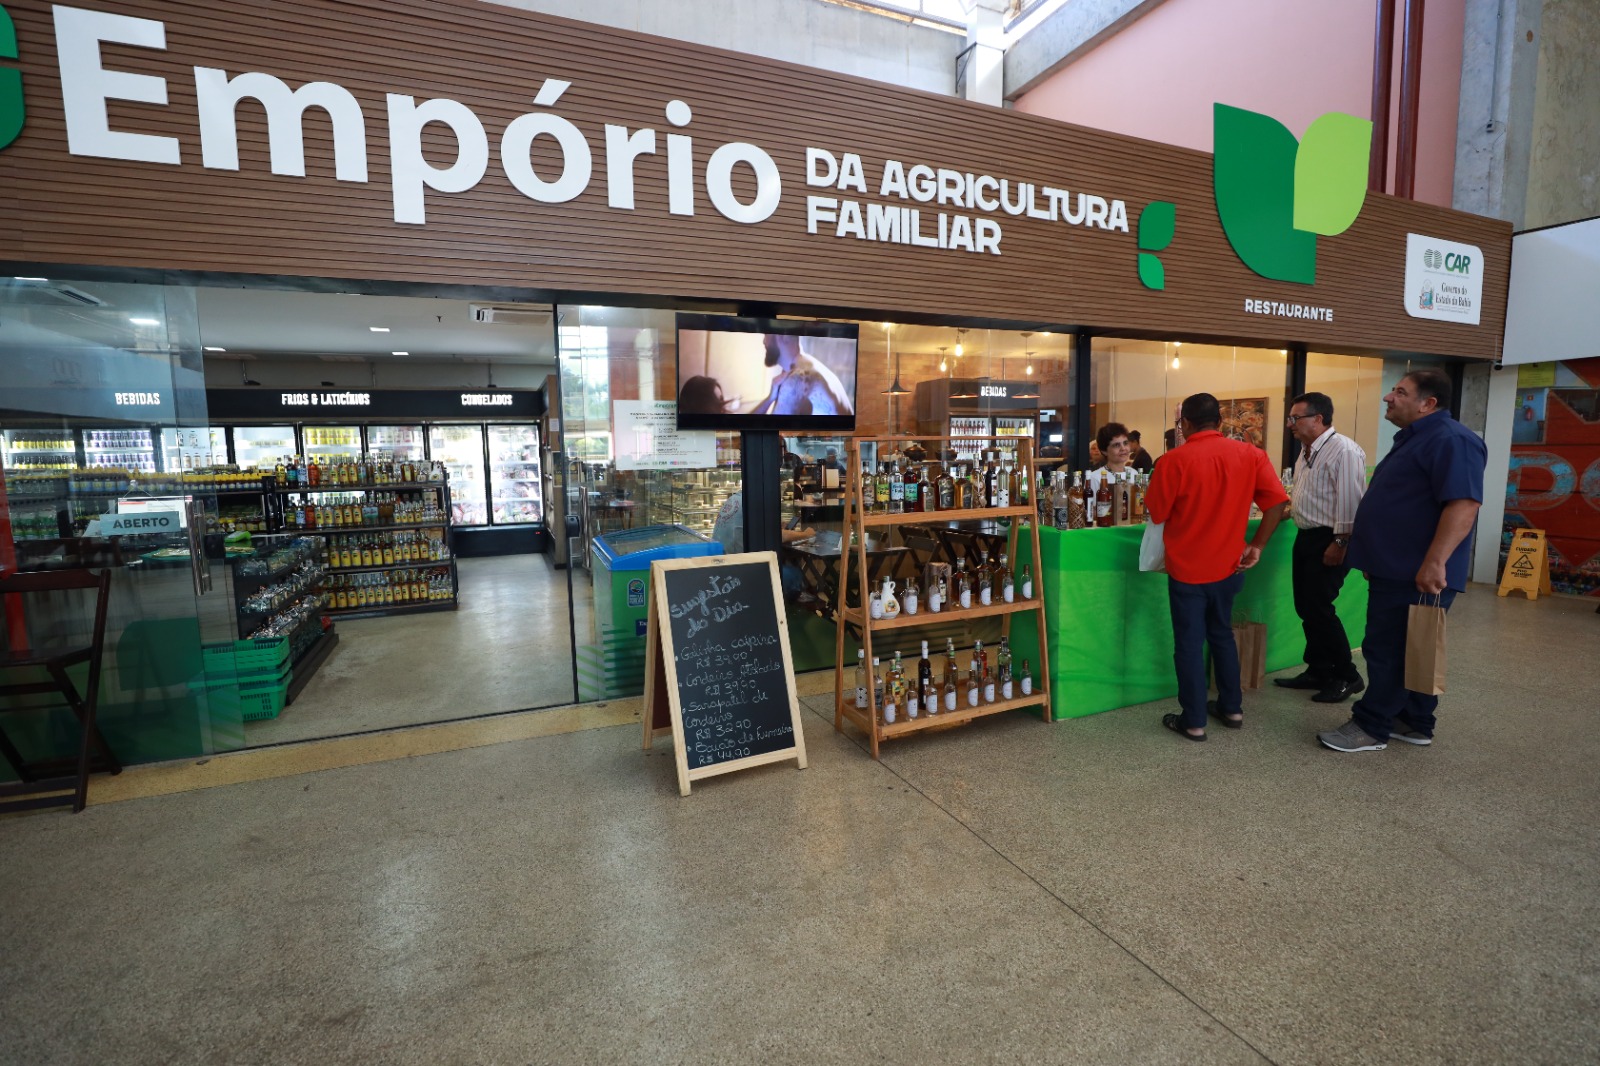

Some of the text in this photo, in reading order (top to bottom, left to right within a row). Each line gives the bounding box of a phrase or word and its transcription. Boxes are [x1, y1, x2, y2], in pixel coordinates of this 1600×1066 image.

[52, 4, 782, 225] Empório
[805, 147, 1130, 233] DA AGRICULTURA
[806, 195, 1002, 255] FAMILIAR
[1445, 252, 1471, 274] CAR
[1245, 299, 1333, 322] RESTAURANTE
[115, 392, 160, 405] BEBIDAS
[281, 393, 309, 405] FRIOS
[320, 391, 370, 405] LATICÍNIOS
[981, 386, 1007, 397] BEBIDAS
[461, 393, 513, 405] CONGELADOS
[113, 517, 170, 529] ABERTO
[696, 656, 710, 669] R$
[686, 670, 733, 687] Cordeiro
[752, 690, 768, 703] de
[685, 712, 733, 728] Cordeiro
[696, 728, 711, 740] R$
[738, 732, 755, 744] de
[699, 747, 750, 765] R$ 44,90
